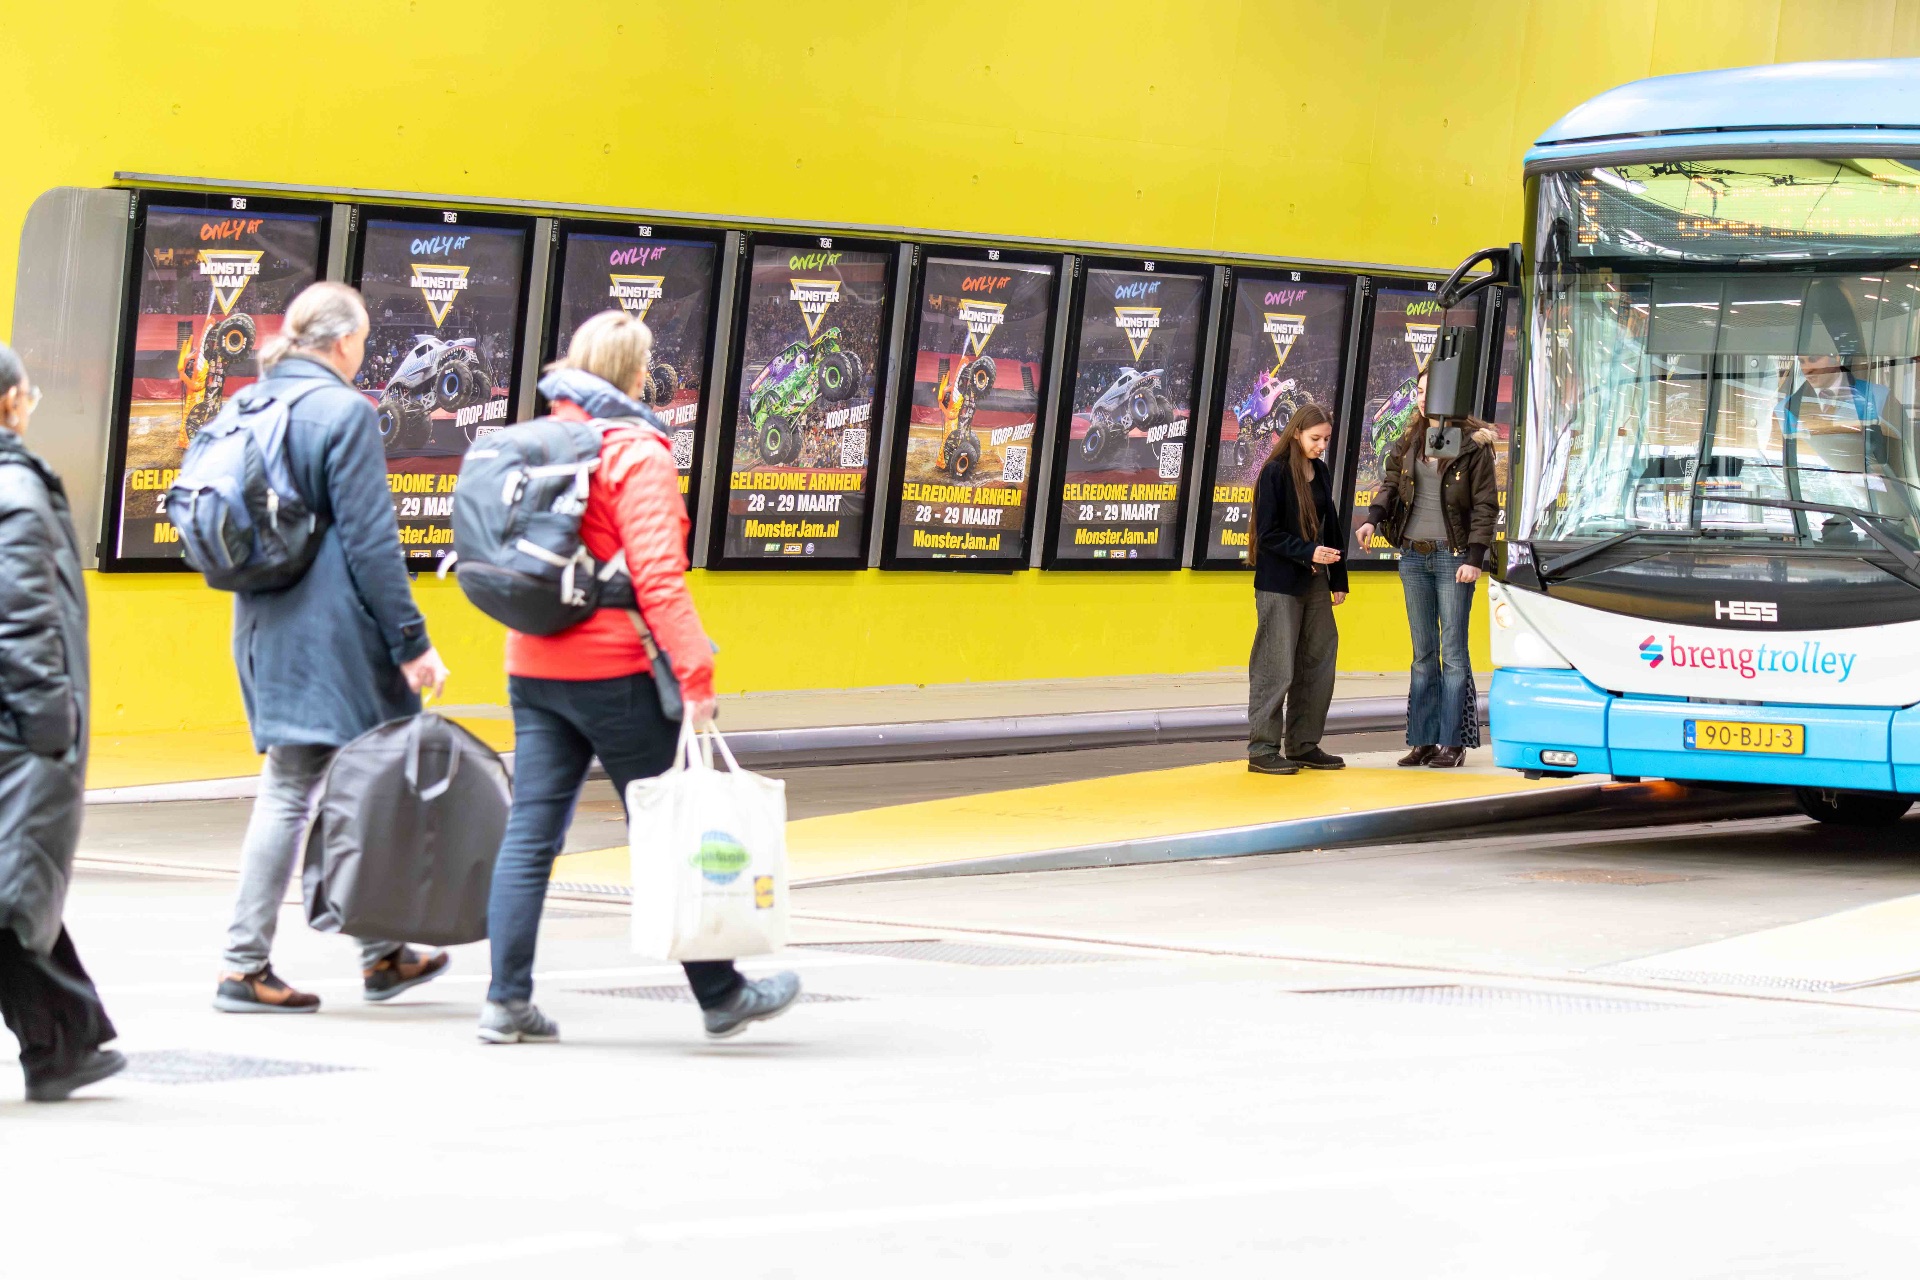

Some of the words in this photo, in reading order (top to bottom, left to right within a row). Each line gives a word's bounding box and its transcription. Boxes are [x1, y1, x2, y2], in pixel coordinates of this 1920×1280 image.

[201, 220, 246, 241] ONLY
[247, 219, 264, 234] AT
[410, 236, 451, 256] ONLY
[454, 236, 470, 250] AT
[610, 246, 650, 266] ONLY
[650, 246, 666, 260] AT
[790, 254, 827, 271] ONLY
[827, 254, 842, 266] AT
[200, 262, 260, 275] MONSTER
[214, 275, 244, 288] JAM
[411, 276, 468, 290] MONSTER
[962, 276, 996, 294] ONLY
[996, 276, 1012, 289] AT
[426, 290, 454, 302] JAM
[610, 286, 662, 298] MONSTER
[790, 290, 840, 302] MONSTER
[1114, 282, 1148, 300] ONLY
[1148, 281, 1161, 294] AT
[1264, 290, 1295, 306] ONLY
[1295, 290, 1308, 302] AT
[624, 298, 648, 310] JAM
[802, 302, 826, 314] JAM
[1406, 300, 1434, 318] ONLY
[1434, 303, 1442, 312] A
[959, 310, 1004, 324] MONSTER
[1116, 317, 1160, 328] MONSTER
[970, 324, 992, 334] JAM
[1128, 328, 1149, 338] JAM
[1264, 322, 1304, 334] MONSTER
[1274, 334, 1294, 344] JAM
[1405, 332, 1438, 344] MONSTE
[1413, 343, 1432, 354] JAM
[456, 405, 484, 428] KOOP
[484, 399, 508, 420] HIER!
[676, 402, 698, 424] HIER!
[826, 408, 850, 430] KOOP
[850, 403, 872, 424] HIER!
[991, 427, 1012, 446] KOOP
[1012, 422, 1034, 440] HIER!
[1146, 424, 1167, 444] KOOP
[1168, 419, 1188, 438] HIER!
[386, 474, 434, 492] EDOME
[730, 472, 808, 490] GELREDOME
[808, 474, 862, 490] ARNHEM
[902, 482, 972, 504] GELREDOME
[972, 488, 1022, 506] ARNHEM
[1063, 484, 1128, 500] GELREDOME
[1130, 484, 1178, 500] ARNHEM
[155, 494, 166, 514] 2
[401, 498, 421, 516] 29
[748, 494, 766, 512] 28
[777, 494, 794, 512] 29
[797, 494, 842, 512] MAART
[915, 505, 932, 522] 28
[944, 506, 960, 524] 29
[962, 508, 1004, 526] MAART
[1079, 504, 1094, 520] 28
[1104, 504, 1118, 520] 29
[1120, 504, 1160, 520] MAART
[1224, 506, 1240, 522] 28
[1498, 510, 1506, 524] 2
[398, 524, 454, 544] sterJam
[744, 520, 840, 538] MonsterJam.nl
[1074, 528, 1158, 544] MonsterJam.nl
[912, 530, 1000, 550] MonsterJam.nl
[1714, 600, 1778, 622] HESS
[1706, 726, 1792, 748] 90-BJJ-3
